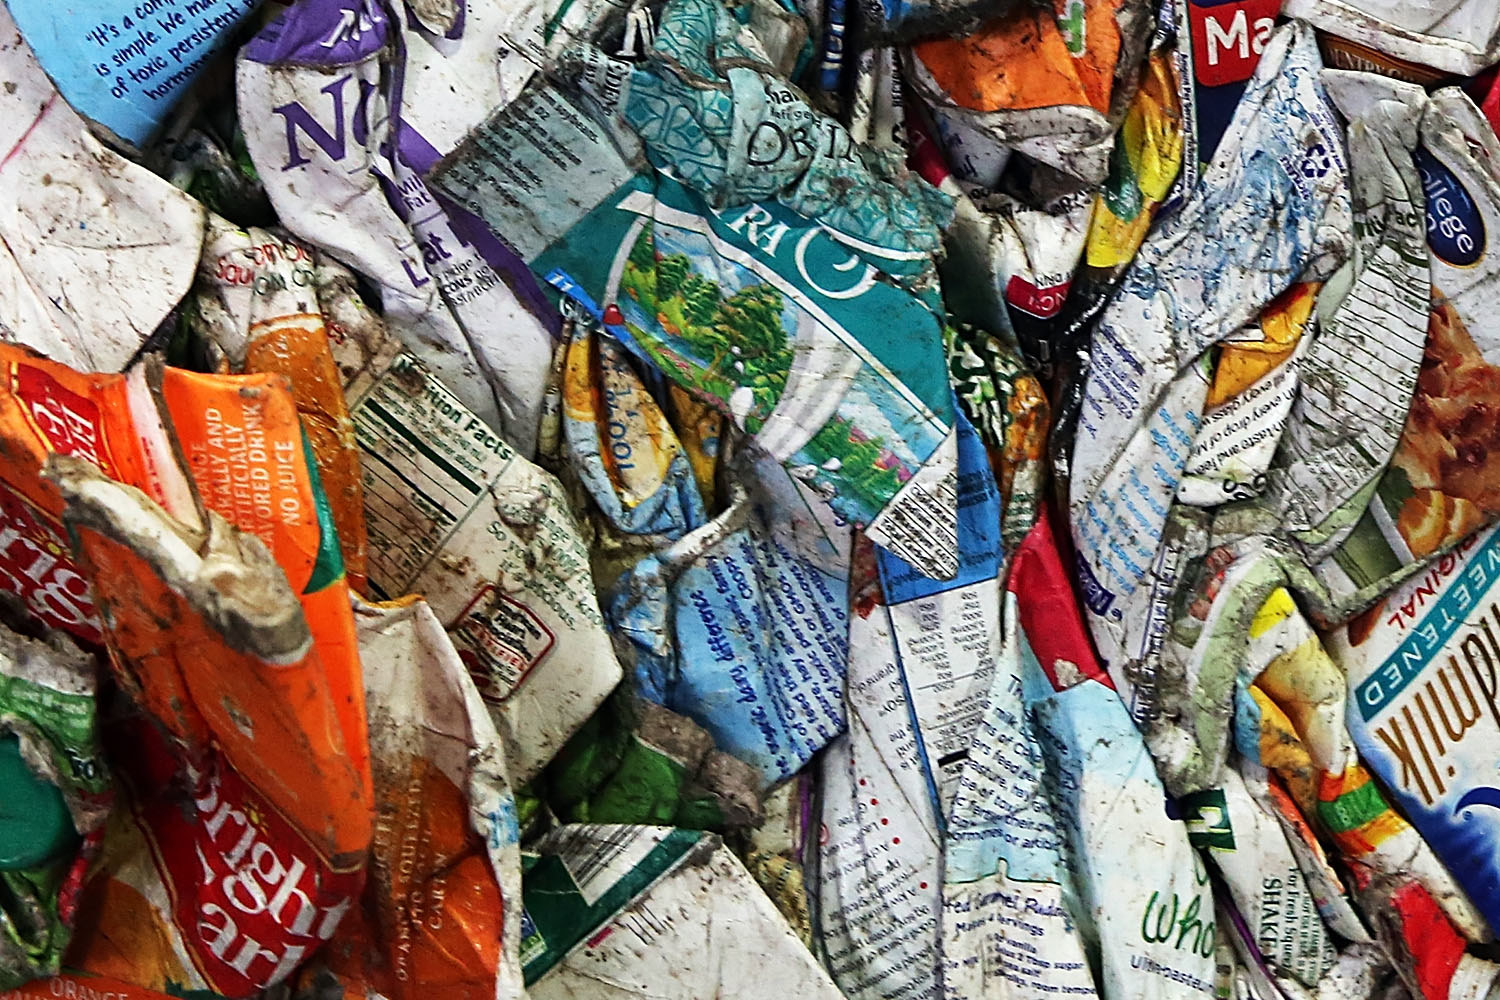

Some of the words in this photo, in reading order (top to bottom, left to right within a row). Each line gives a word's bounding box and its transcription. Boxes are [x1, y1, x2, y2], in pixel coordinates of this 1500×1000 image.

[112, 31, 159, 68] simple.
[156, 12, 186, 34] We
[123, 15, 135, 30] a
[110, 76, 129, 99] of
[127, 55, 169, 84] toxic
[168, 9, 241, 64] persistent
[206, 408, 223, 447] AND
[244, 404, 267, 462] DRINK
[276, 440, 296, 493] JUICE
[280, 497, 299, 525] NO
